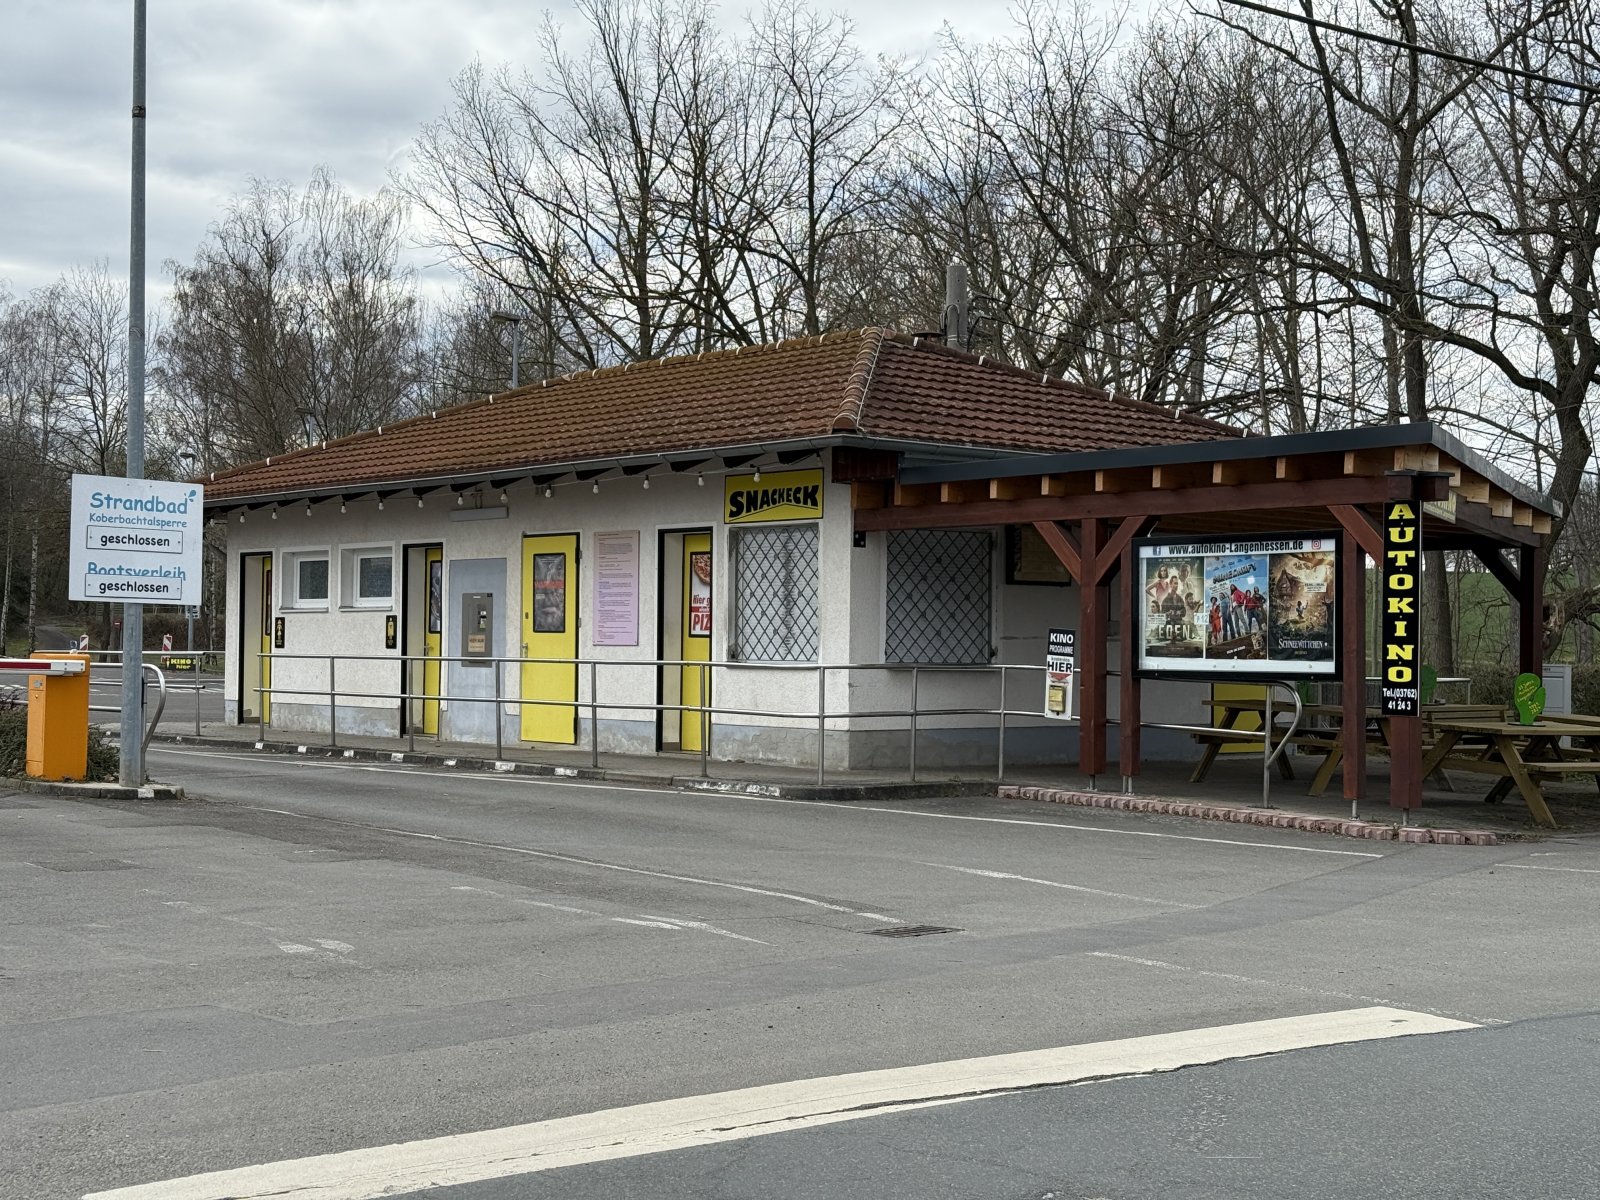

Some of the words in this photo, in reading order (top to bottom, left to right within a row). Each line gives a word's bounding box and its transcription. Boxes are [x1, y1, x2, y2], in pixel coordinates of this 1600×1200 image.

[90, 492, 188, 514] Strandbad
[729, 485, 819, 517] SNACKECK
[89, 513, 187, 528] Koberbachtalsperre
[100, 534, 170, 546] geschlossen
[1168, 540, 1303, 555] www.autokino-Langenhessen.de
[99, 581, 169, 594] geschlossen
[1387, 504, 1415, 682] AUTOKINO
[1050, 633, 1074, 644] KINO
[1158, 624, 1190, 639] EDEN
[1047, 661, 1073, 673] HIER
